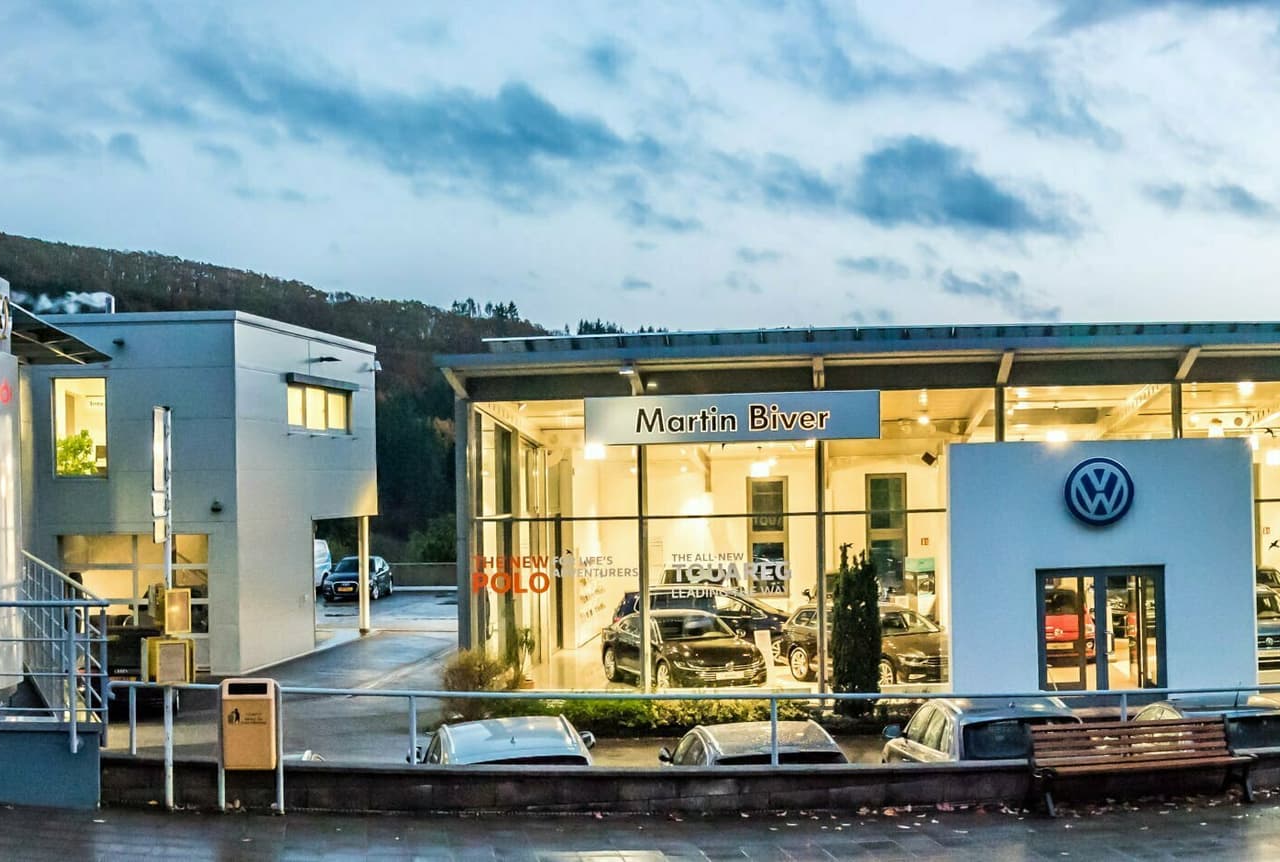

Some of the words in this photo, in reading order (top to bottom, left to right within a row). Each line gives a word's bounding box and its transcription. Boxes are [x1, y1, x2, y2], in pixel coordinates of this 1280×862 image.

[635, 406, 738, 433] Martin
[748, 403, 831, 432] Biver
[472, 555, 504, 569] THE
[510, 555, 549, 569] NEW
[672, 553, 692, 562] THE
[472, 571, 551, 595] POLO
[672, 561, 792, 583] TOUAREG
